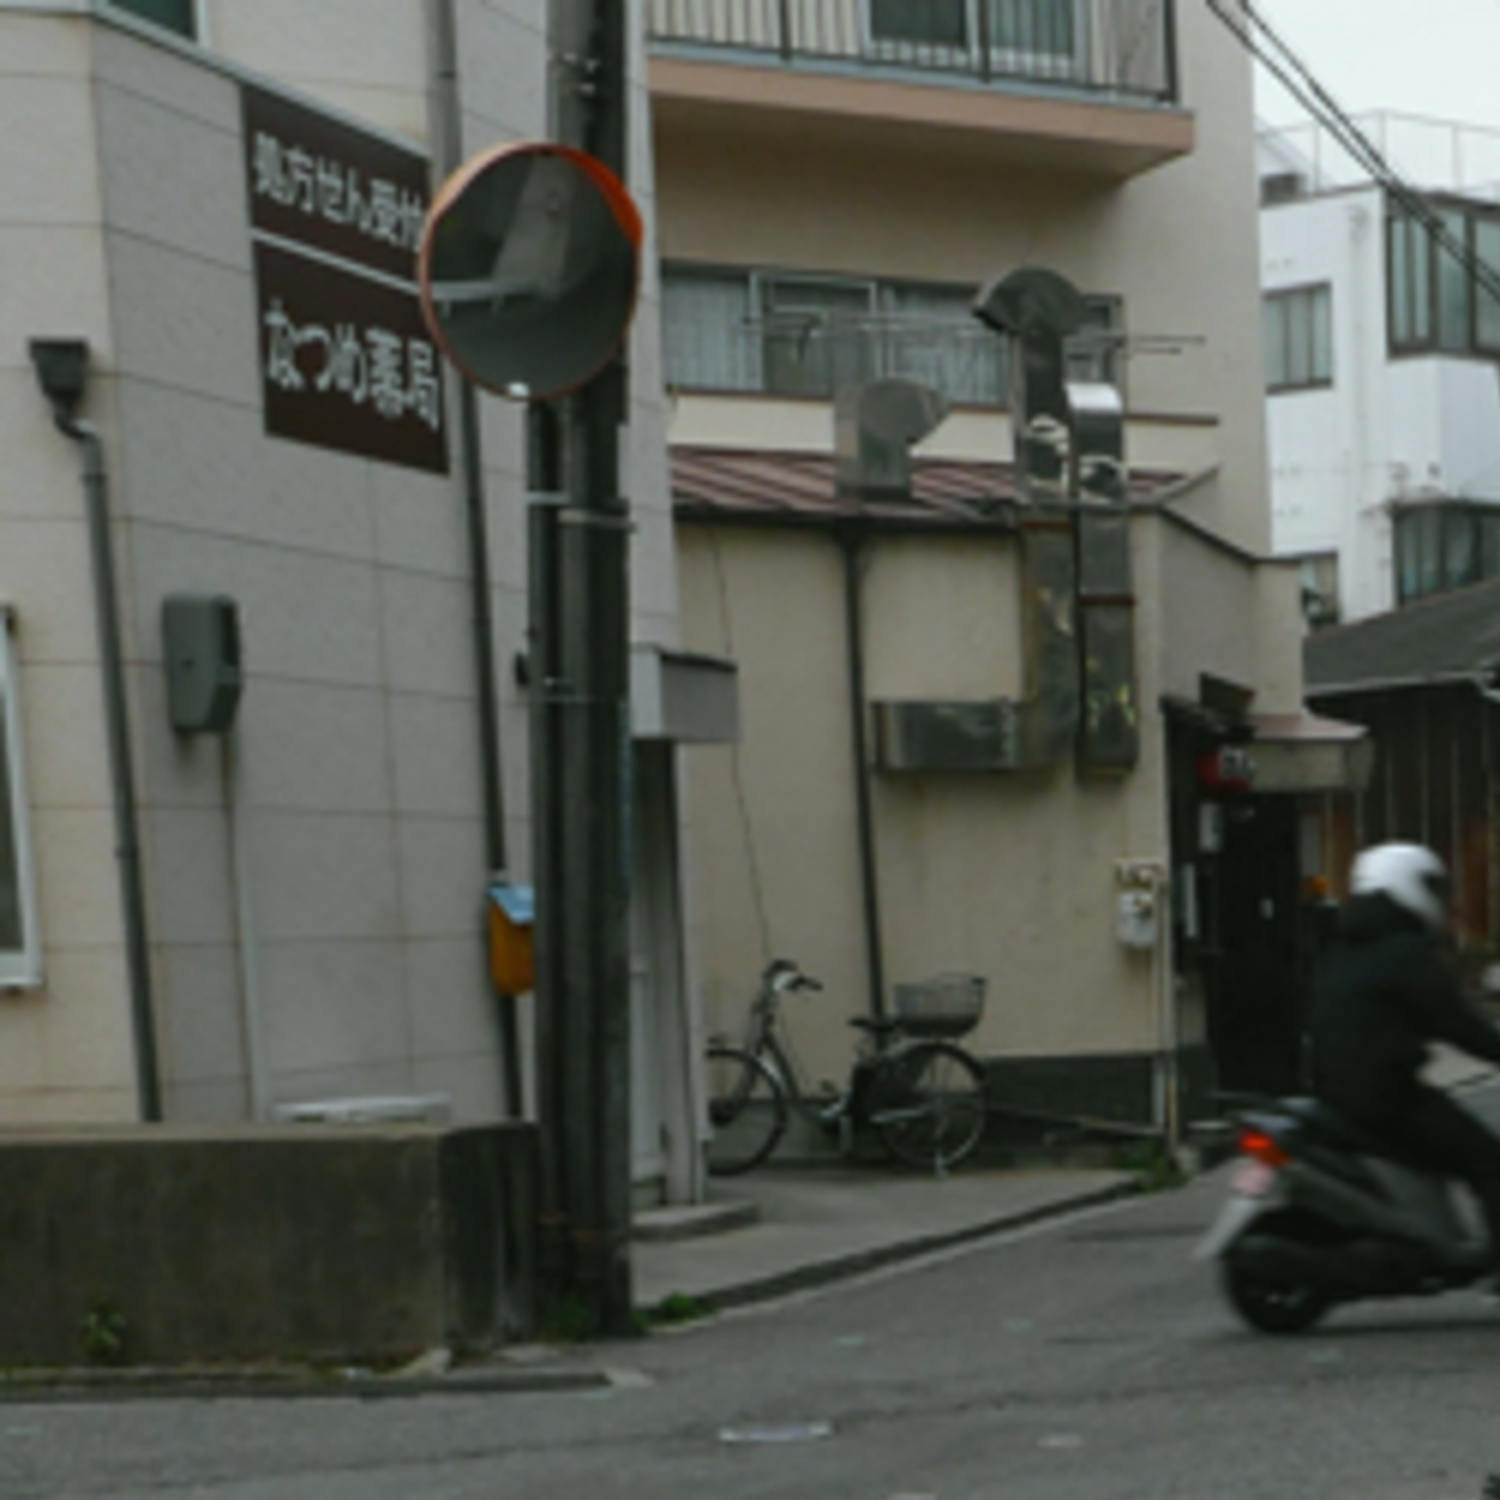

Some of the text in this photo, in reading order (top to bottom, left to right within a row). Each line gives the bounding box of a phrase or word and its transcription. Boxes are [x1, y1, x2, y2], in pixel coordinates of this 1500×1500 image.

[263, 295, 440, 432] なつめ薬局
